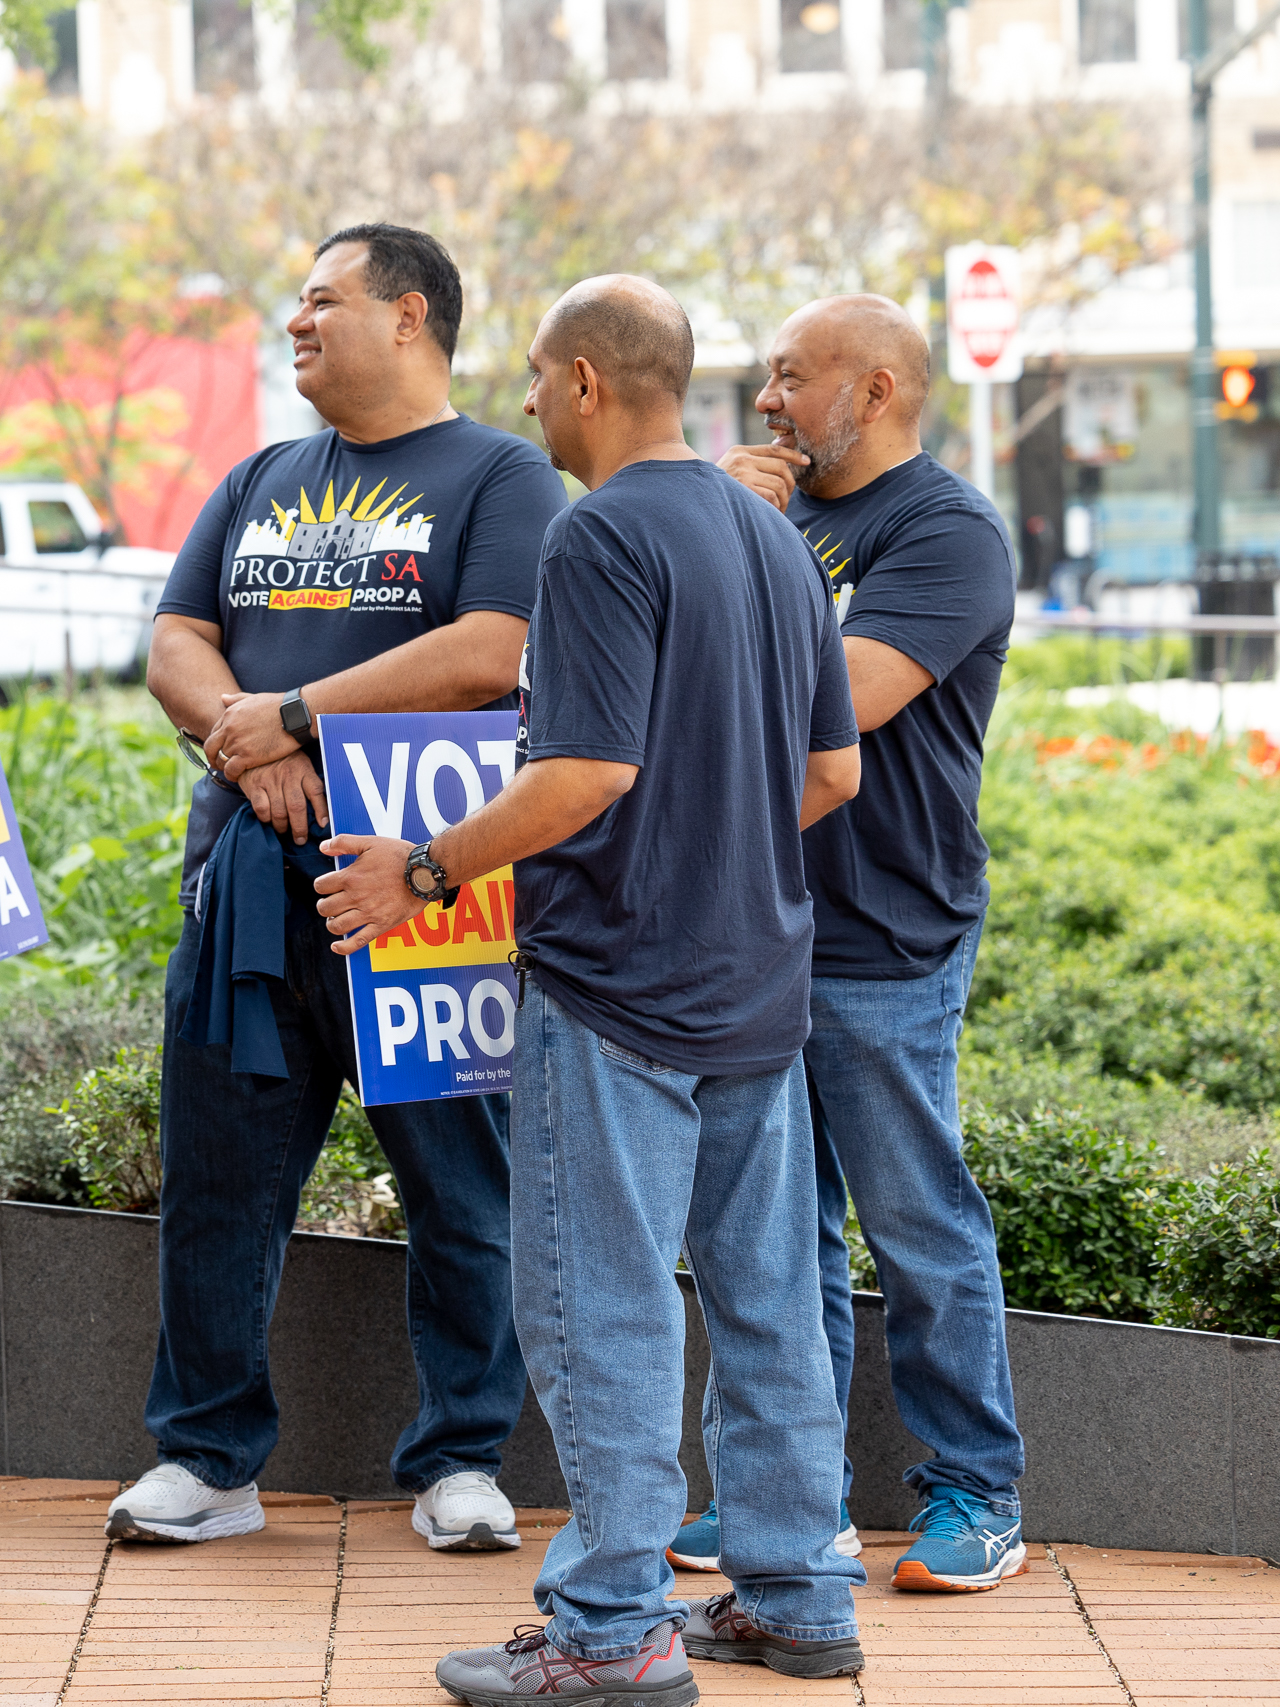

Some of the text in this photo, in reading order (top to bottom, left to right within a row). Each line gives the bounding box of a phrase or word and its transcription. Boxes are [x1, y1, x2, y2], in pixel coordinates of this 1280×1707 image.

[229, 552, 424, 588] PROTECT SA
[228, 587, 423, 608] VOTE AGAINST PROP A
[374, 978, 515, 1066] PRO
[456, 1067, 511, 1082] Paid for by the
